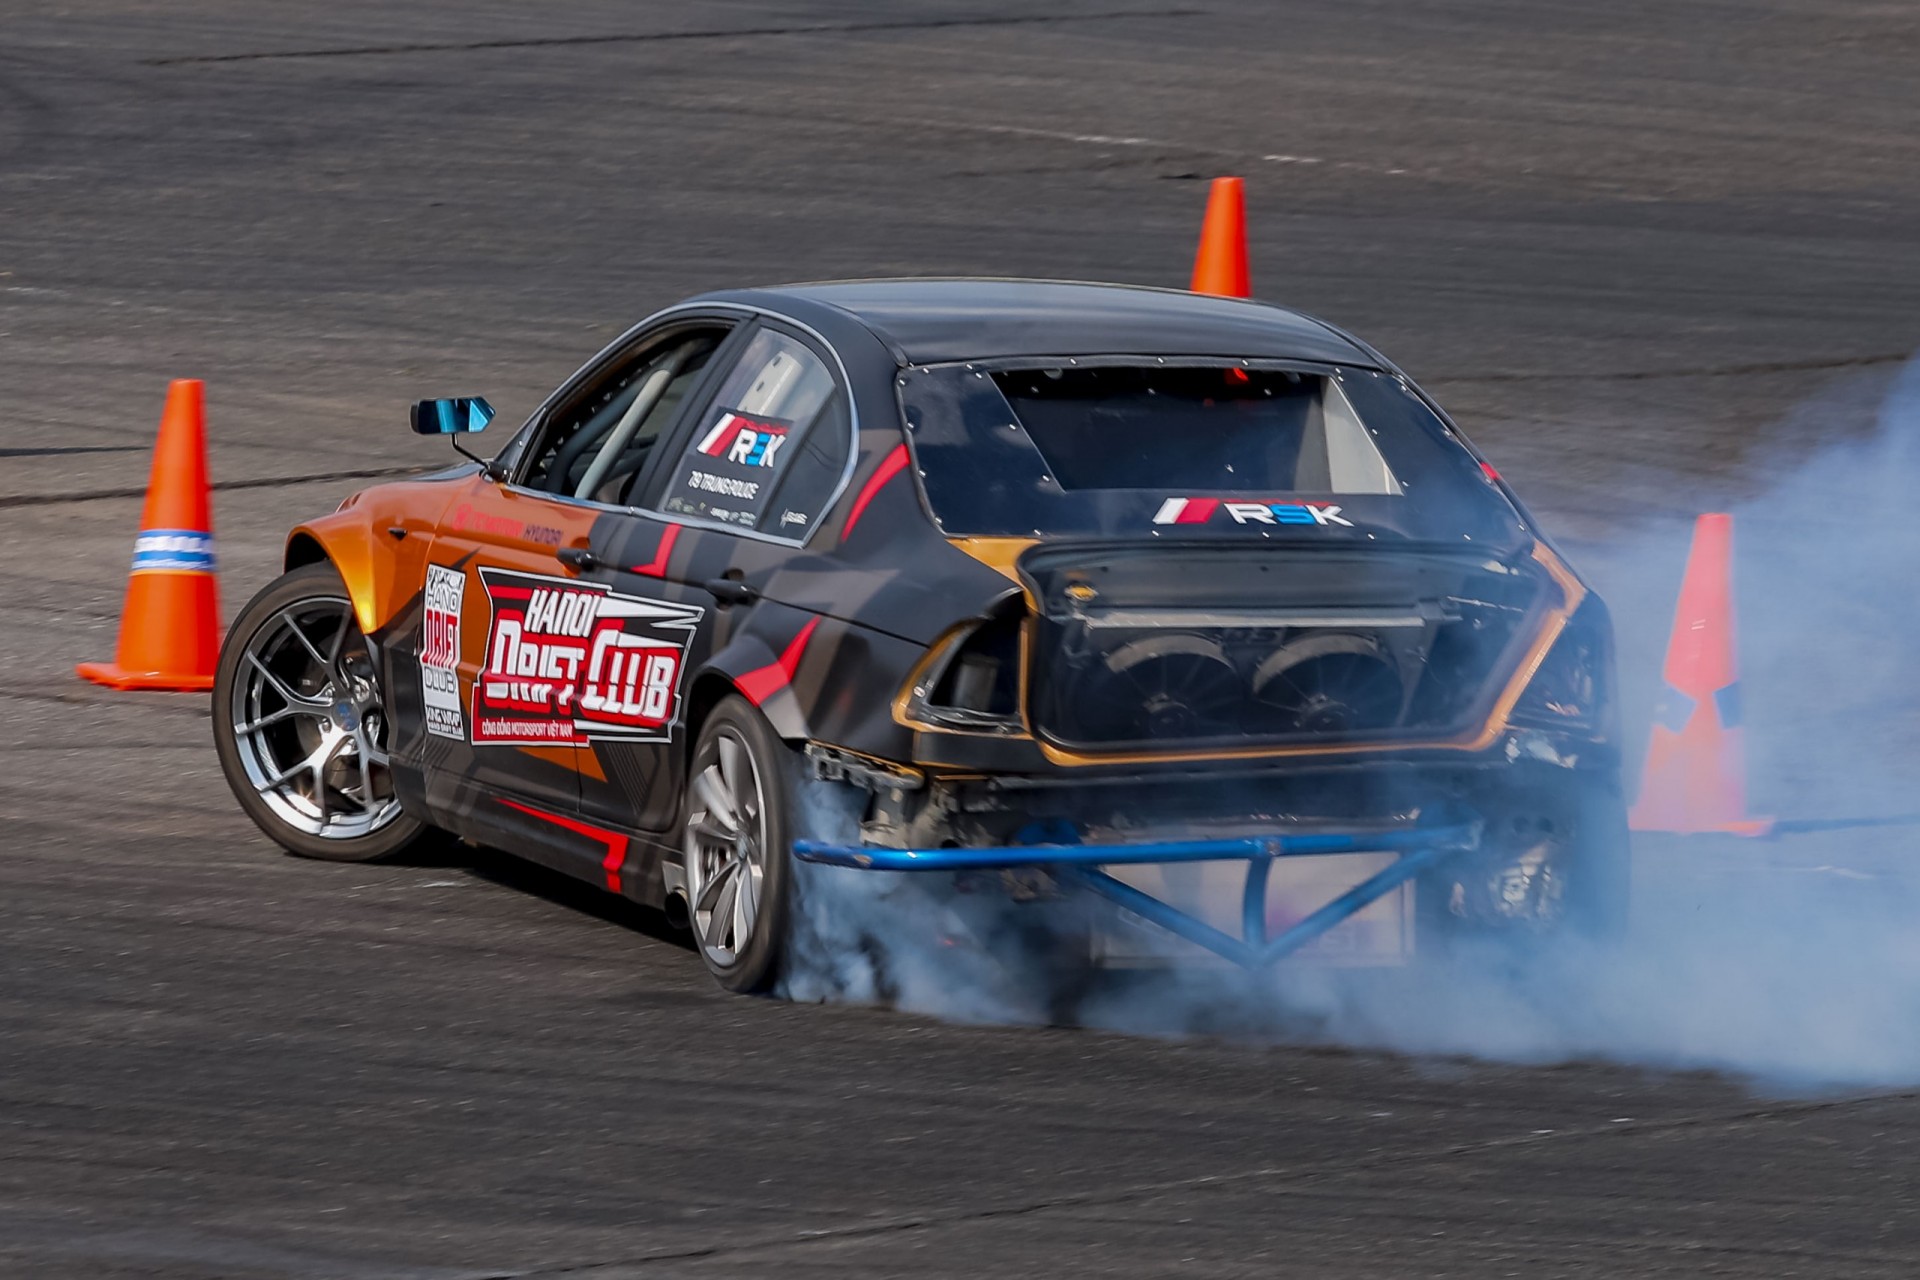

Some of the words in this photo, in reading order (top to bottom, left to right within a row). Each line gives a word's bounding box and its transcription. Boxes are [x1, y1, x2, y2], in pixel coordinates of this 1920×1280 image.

[728, 428, 786, 468] RSK
[1224, 503, 1355, 527] RSK
[523, 588, 601, 638] HANOI
[422, 609, 458, 670] DRIFT
[486, 619, 586, 706] DRIFT
[580, 629, 676, 720] CLUB
[511, 721, 547, 737] MOTORSPORT
[559, 723, 573, 738] NAM
